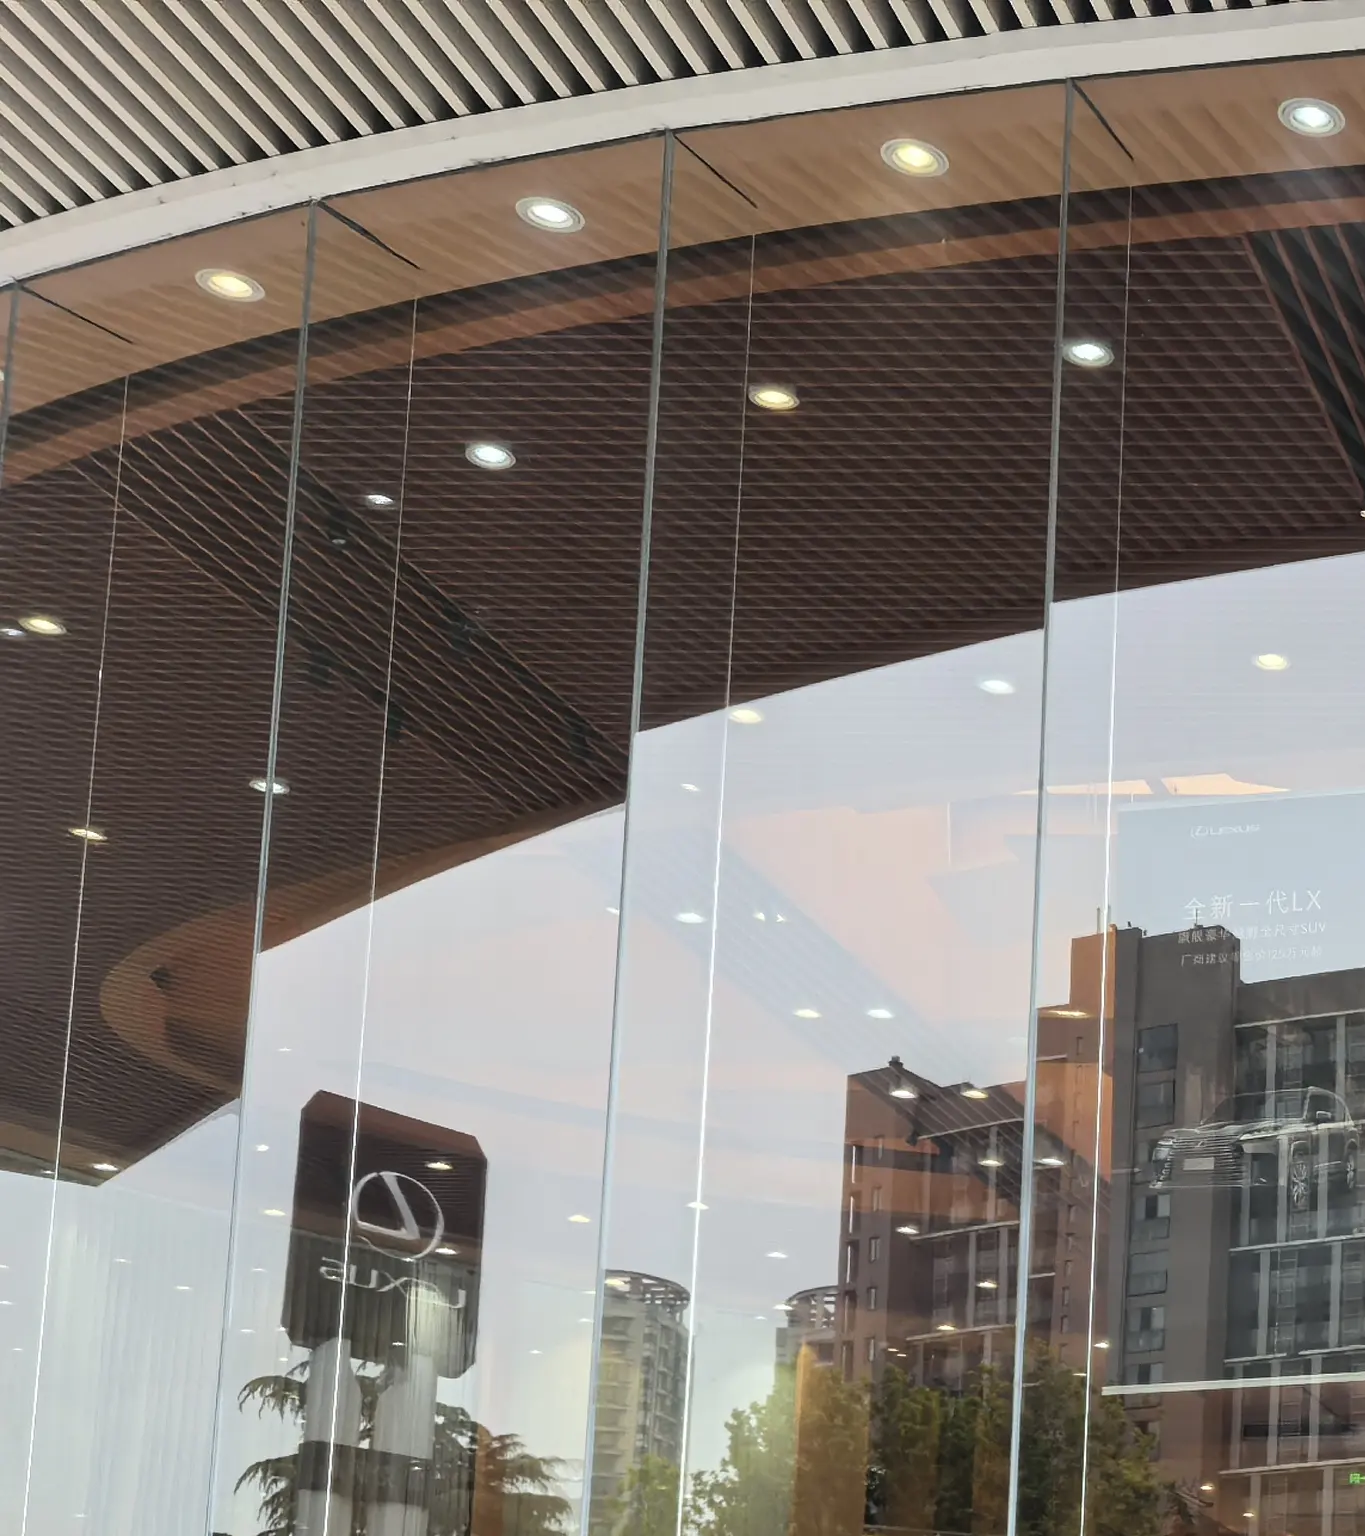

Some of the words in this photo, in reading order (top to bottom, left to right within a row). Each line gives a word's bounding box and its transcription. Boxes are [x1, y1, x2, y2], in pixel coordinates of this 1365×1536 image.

[1209, 824, 1260, 836] LEXUS
[1182, 890, 1322, 920] 全新一代LX
